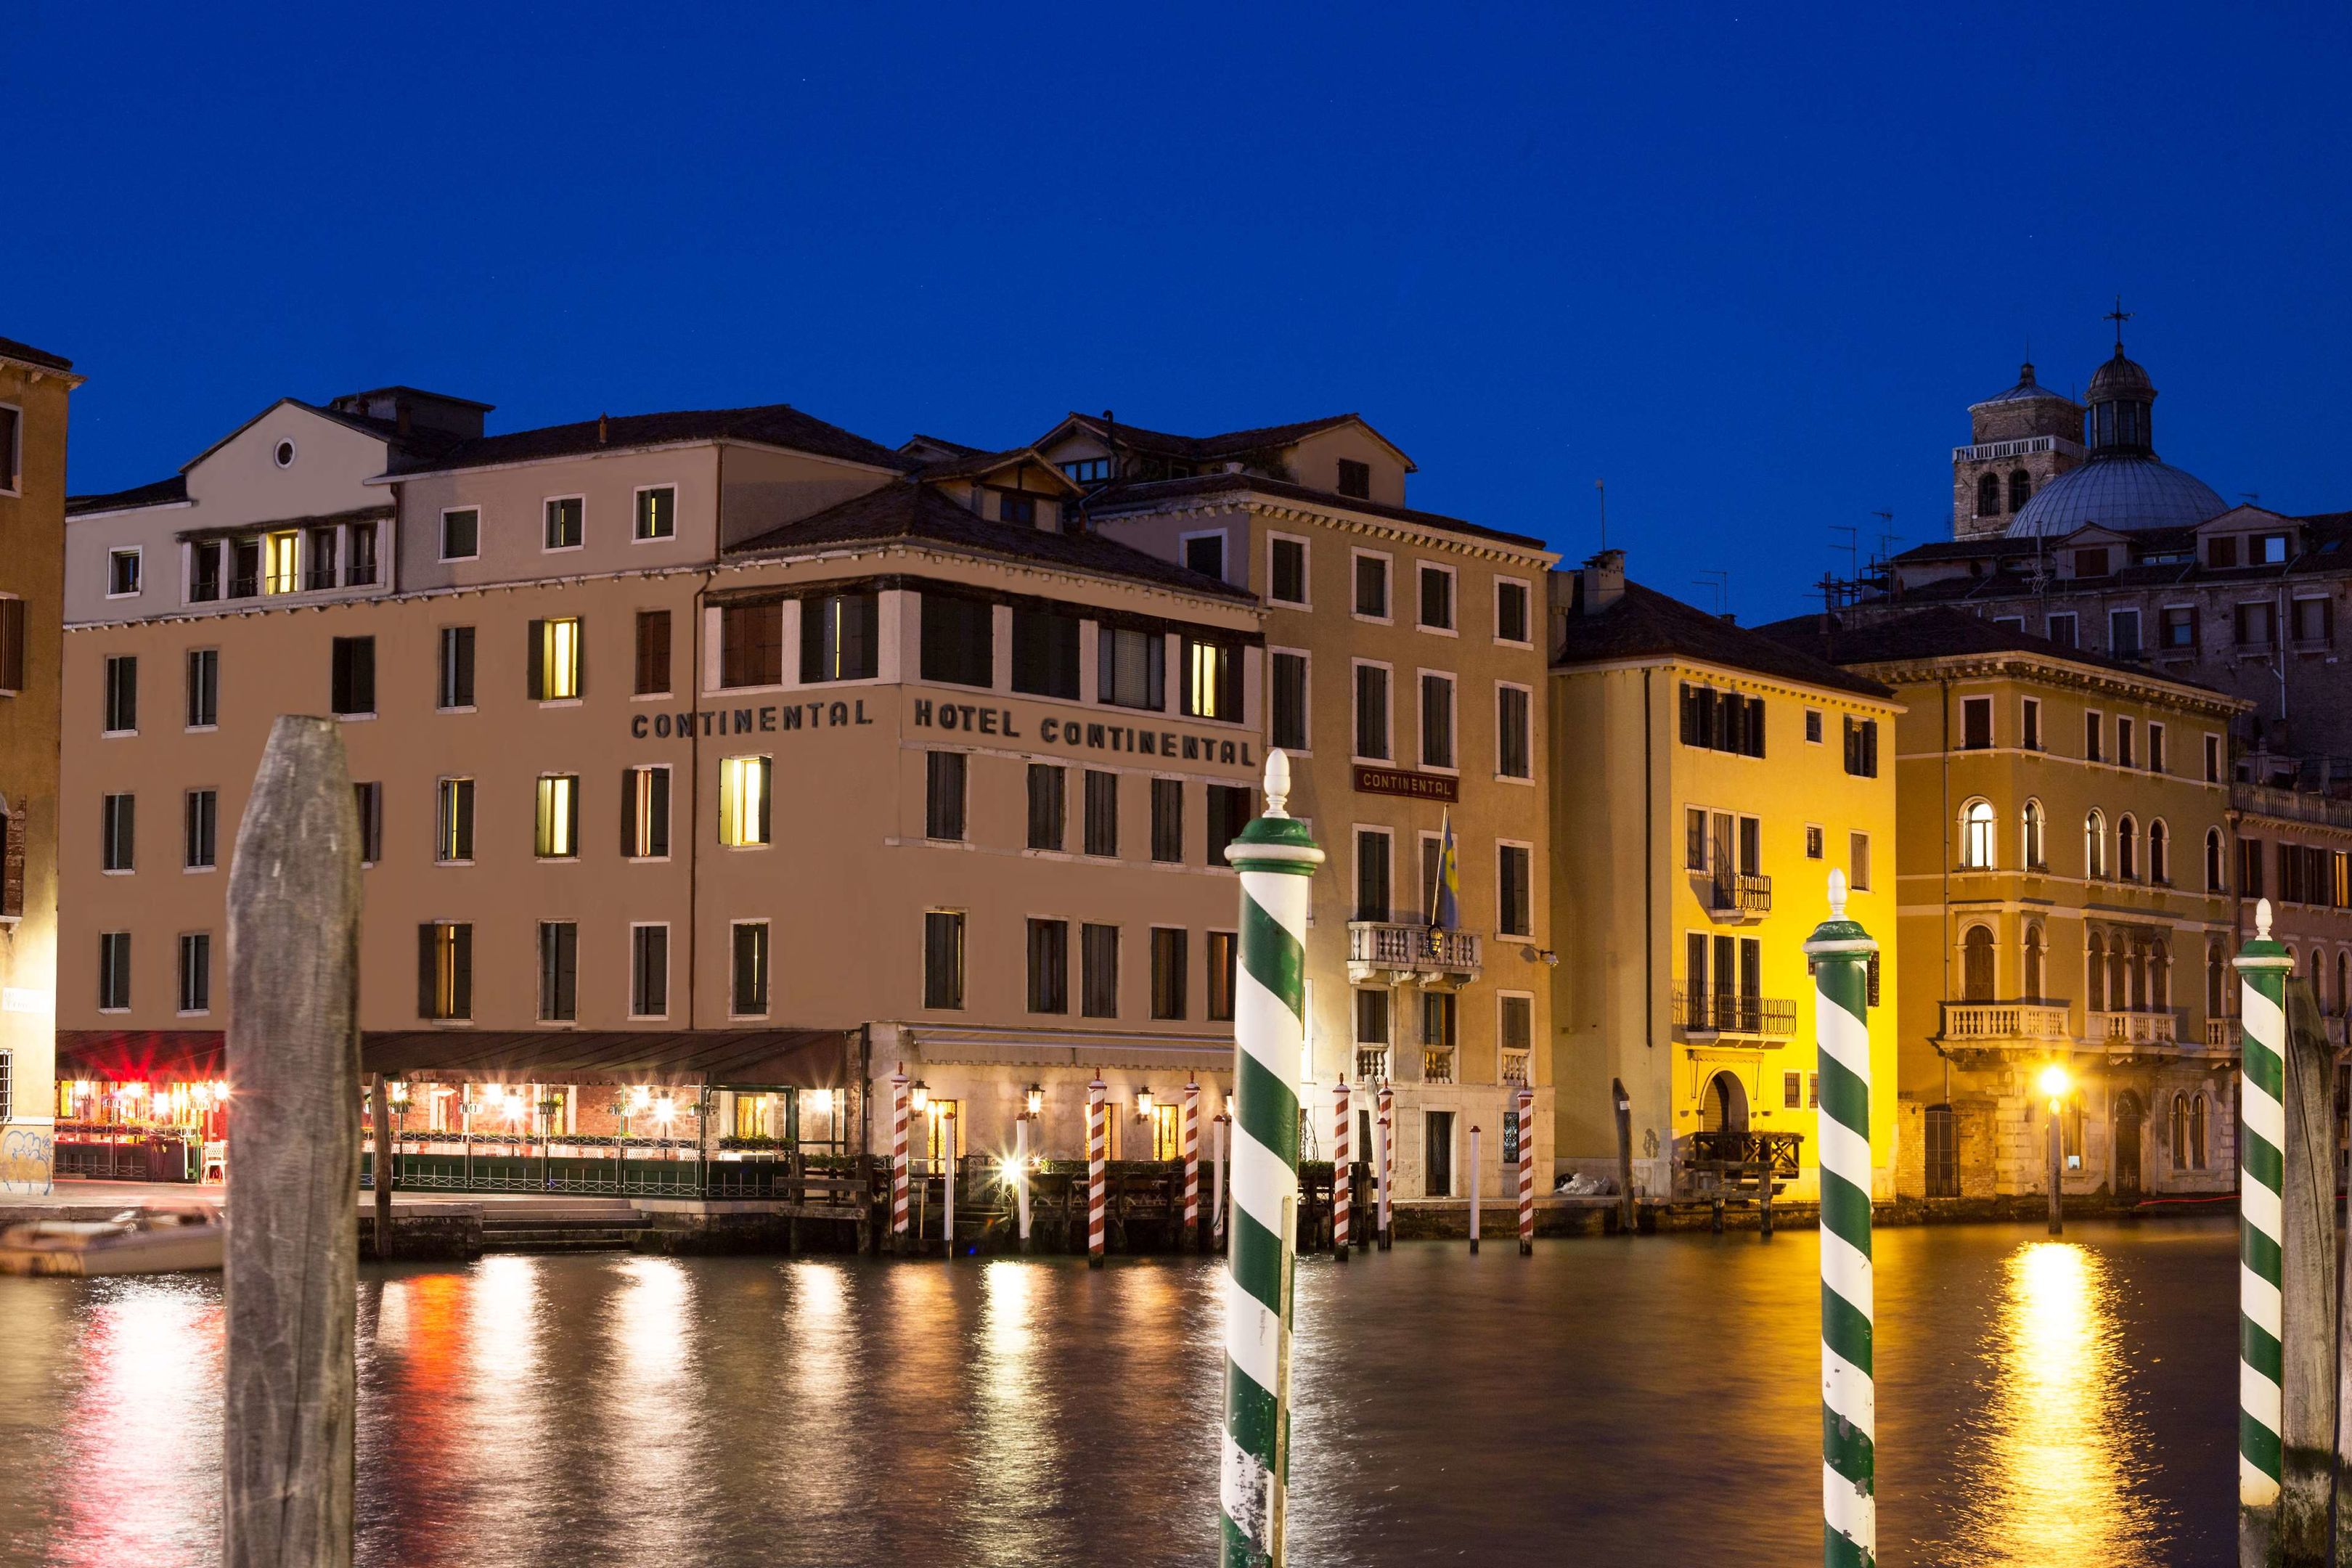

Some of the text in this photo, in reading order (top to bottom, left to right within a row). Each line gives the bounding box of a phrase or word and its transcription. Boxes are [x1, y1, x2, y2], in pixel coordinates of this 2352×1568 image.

[631, 699, 873, 739] CONTINENTAL
[915, 699, 1257, 767] HOTEL CONTINENTAL
[1363, 773, 1451, 796] CONTINENTAL
